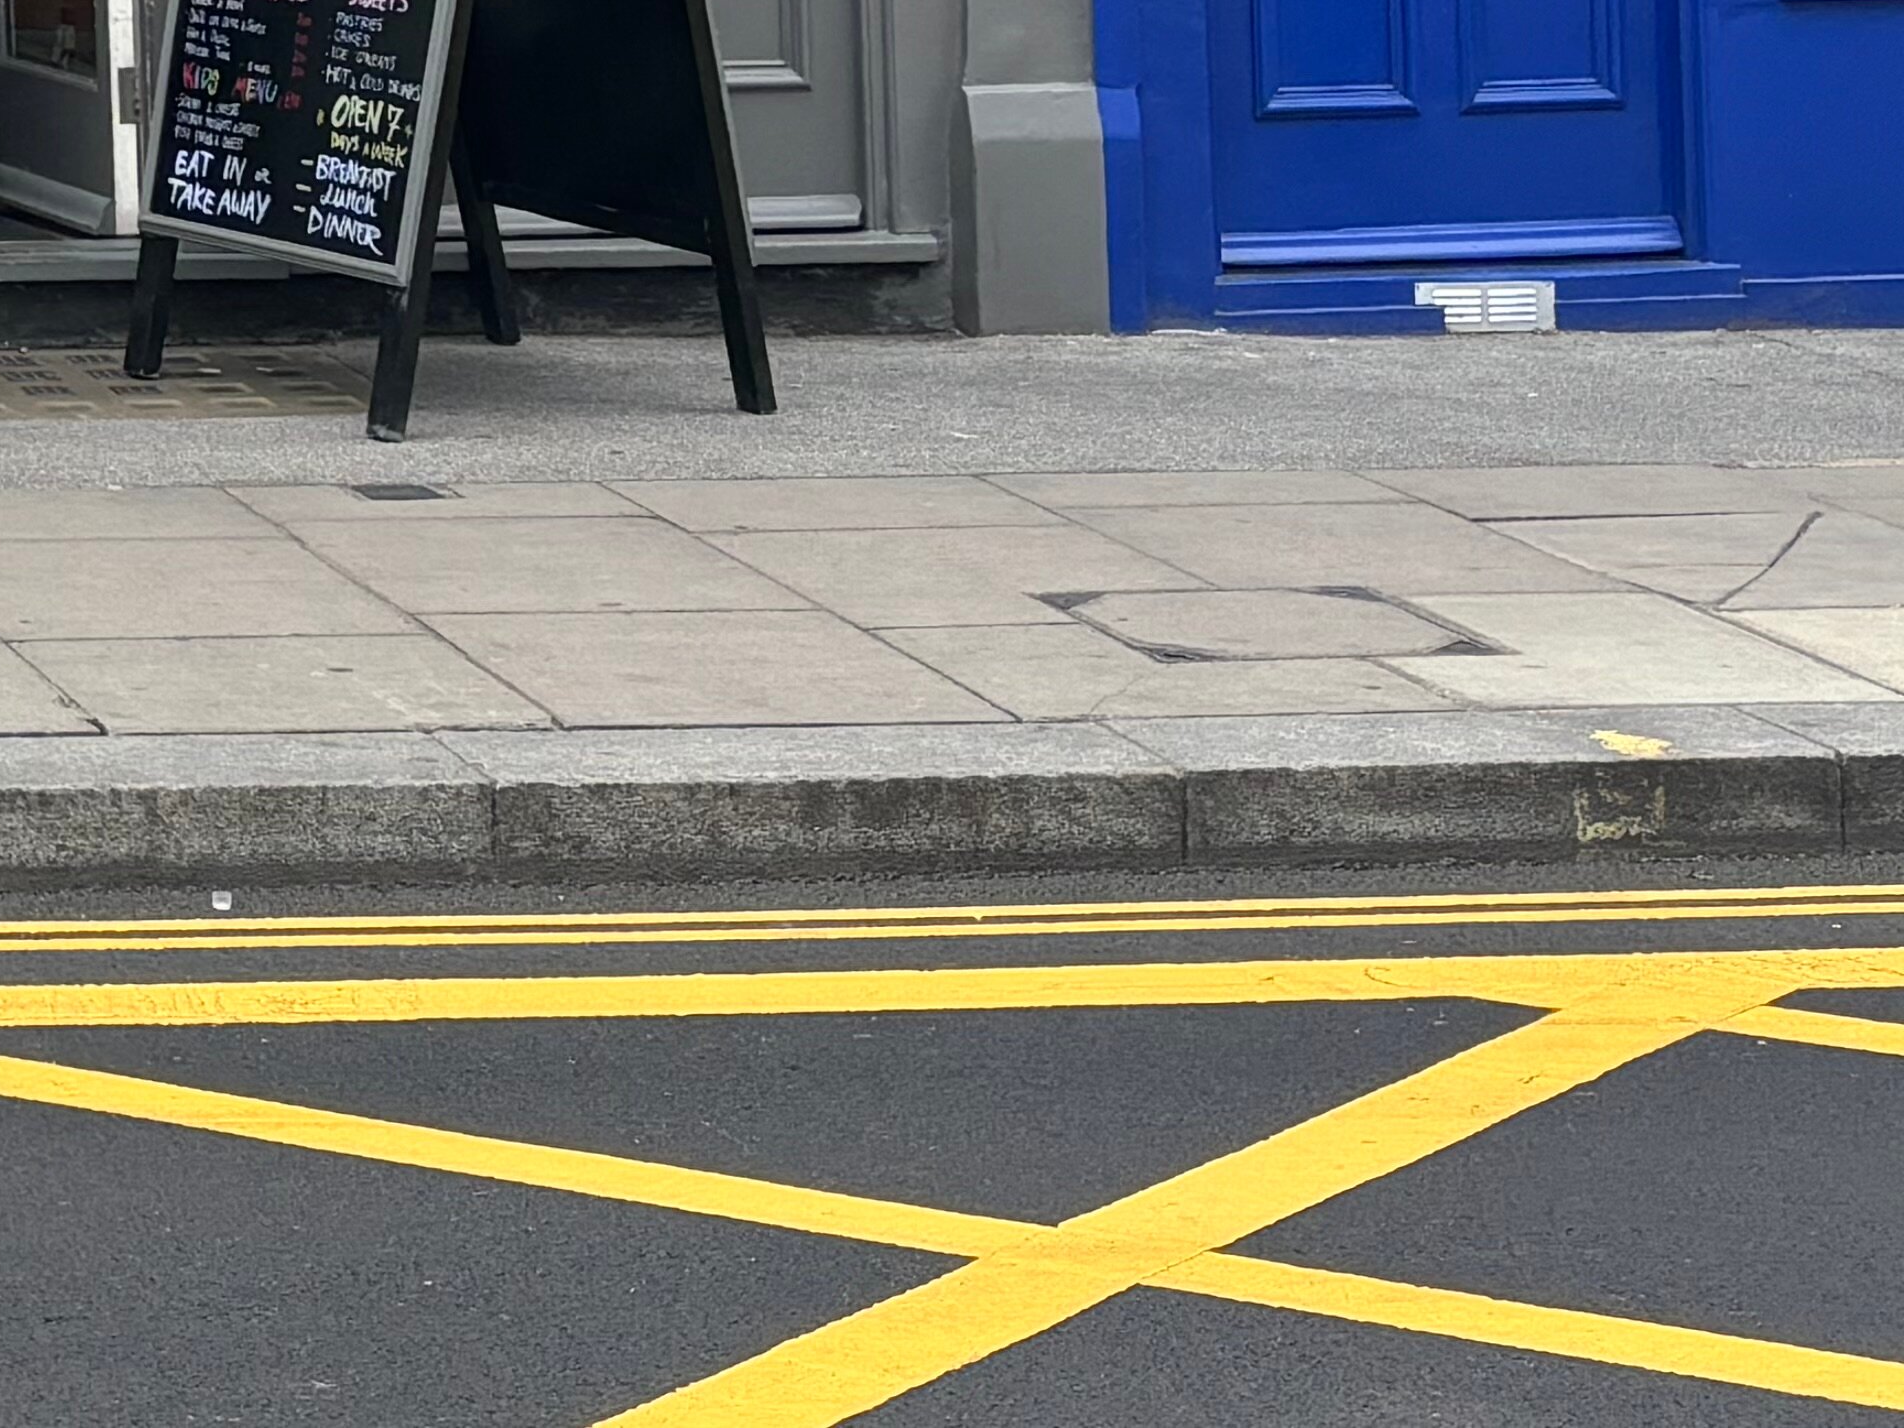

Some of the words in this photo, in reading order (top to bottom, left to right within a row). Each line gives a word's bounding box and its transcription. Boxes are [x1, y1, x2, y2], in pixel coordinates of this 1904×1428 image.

[183, 62, 220, 96] KIDS
[232, 77, 278, 104] MENU
[330, 94, 384, 135] OPEN
[387, 104, 405, 142] 7
[330, 131, 360, 155] DAYS
[174, 149, 215, 181] EAT
[223, 154, 247, 186] IN
[167, 177, 216, 215] TAKE
[216, 187, 272, 225] AWAY
[307, 206, 384, 256] DINNER
